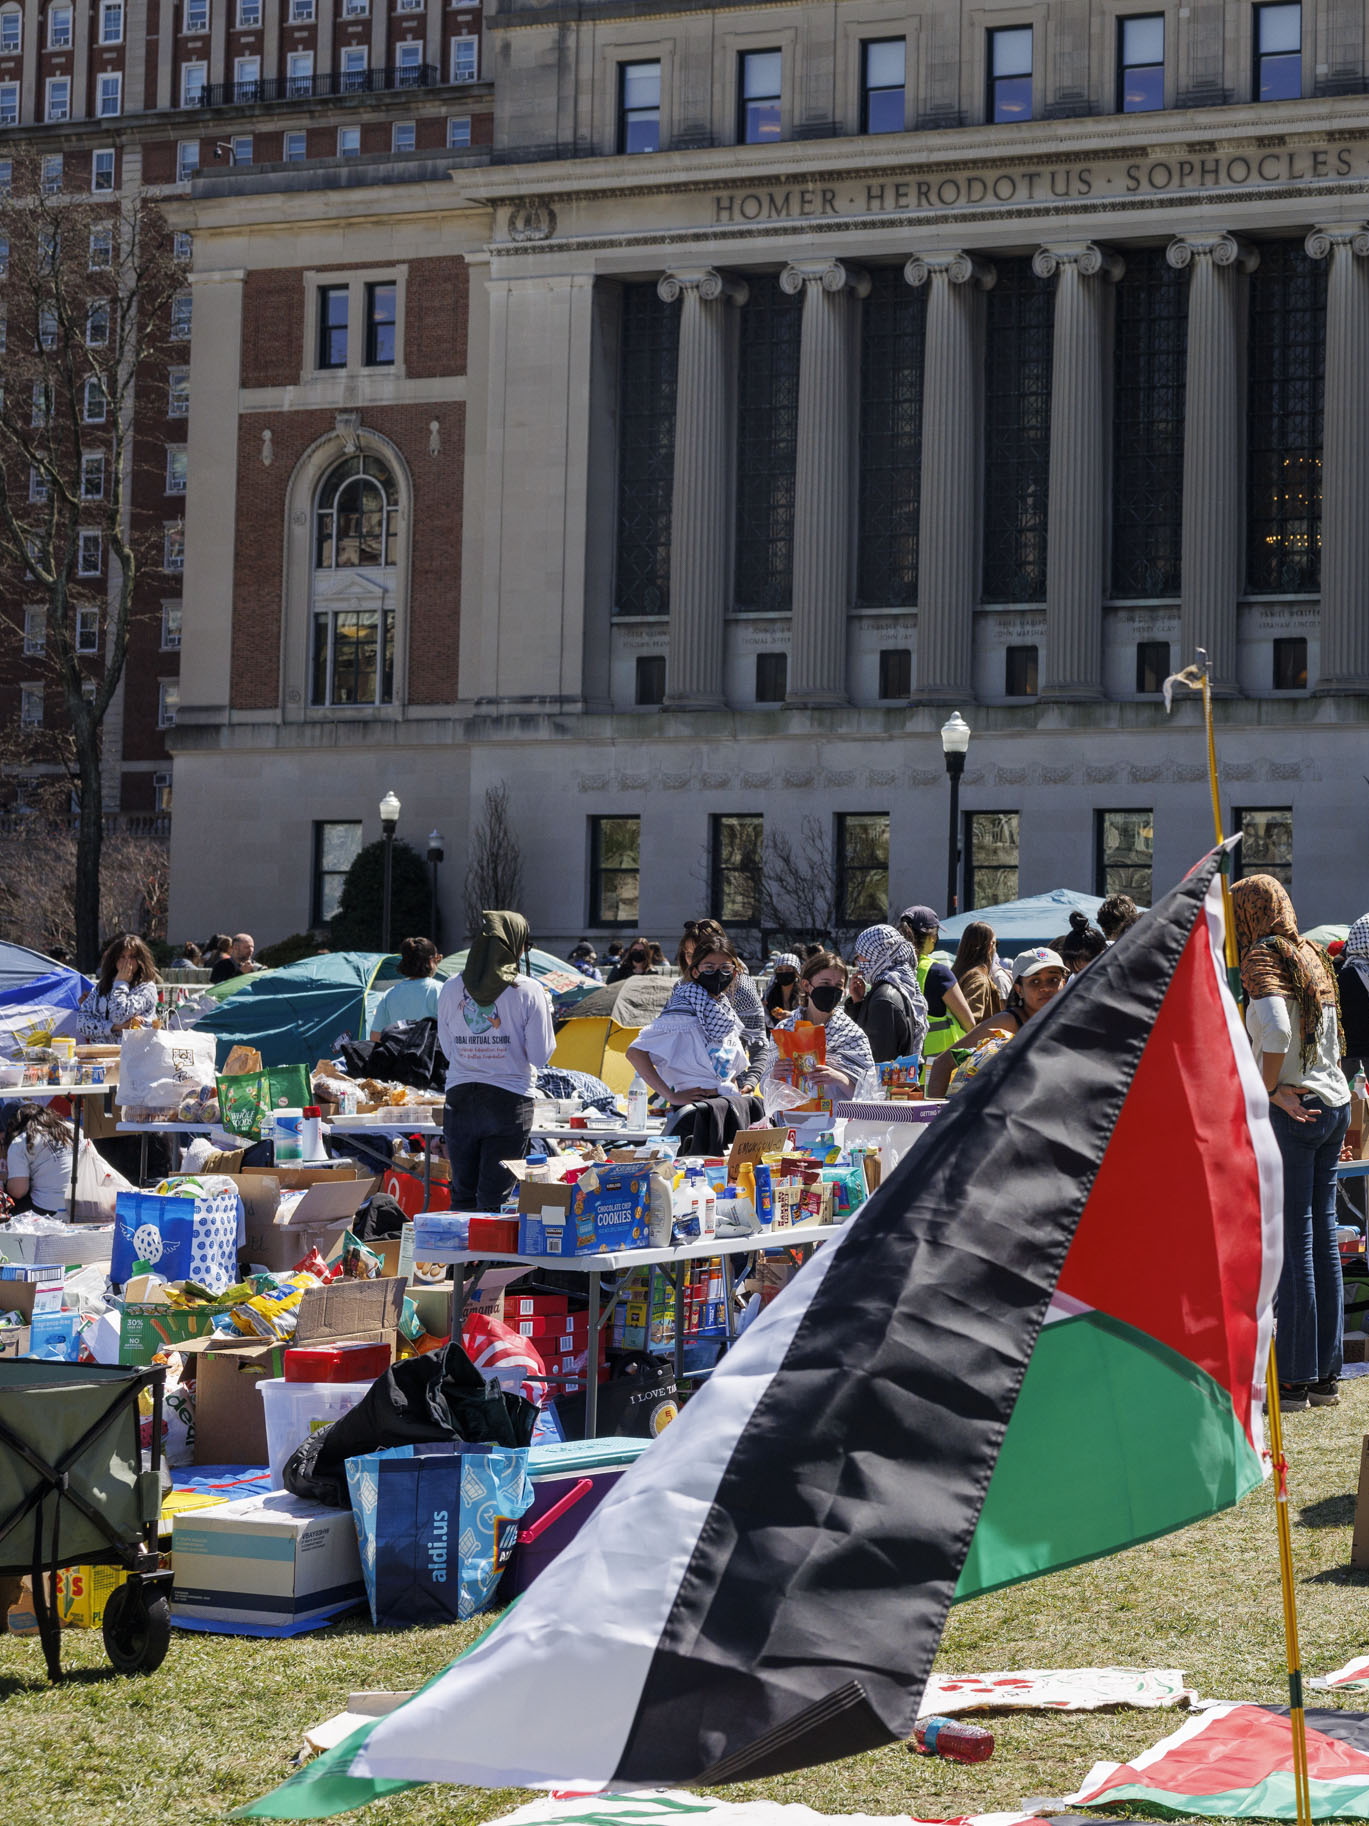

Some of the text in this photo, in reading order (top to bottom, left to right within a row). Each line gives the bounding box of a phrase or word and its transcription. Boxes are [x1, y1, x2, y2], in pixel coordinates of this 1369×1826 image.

[714, 187, 840, 222] HOMER
[865, 167, 1093, 212] HERODOTUS
[1125, 147, 1353, 192] SOPHOCLES
[468, 1036, 490, 1045] VIRTUAL
[919, 1110, 937, 1118] GETTING
[597, 1201, 632, 1213] CHOCOLATE CHIP
[597, 1210, 632, 1226] COOKIES
[630, 1396, 635, 1404] I
[637, 1388, 666, 1402] LOVE
[427, 1510, 448, 1583] aldi.us
